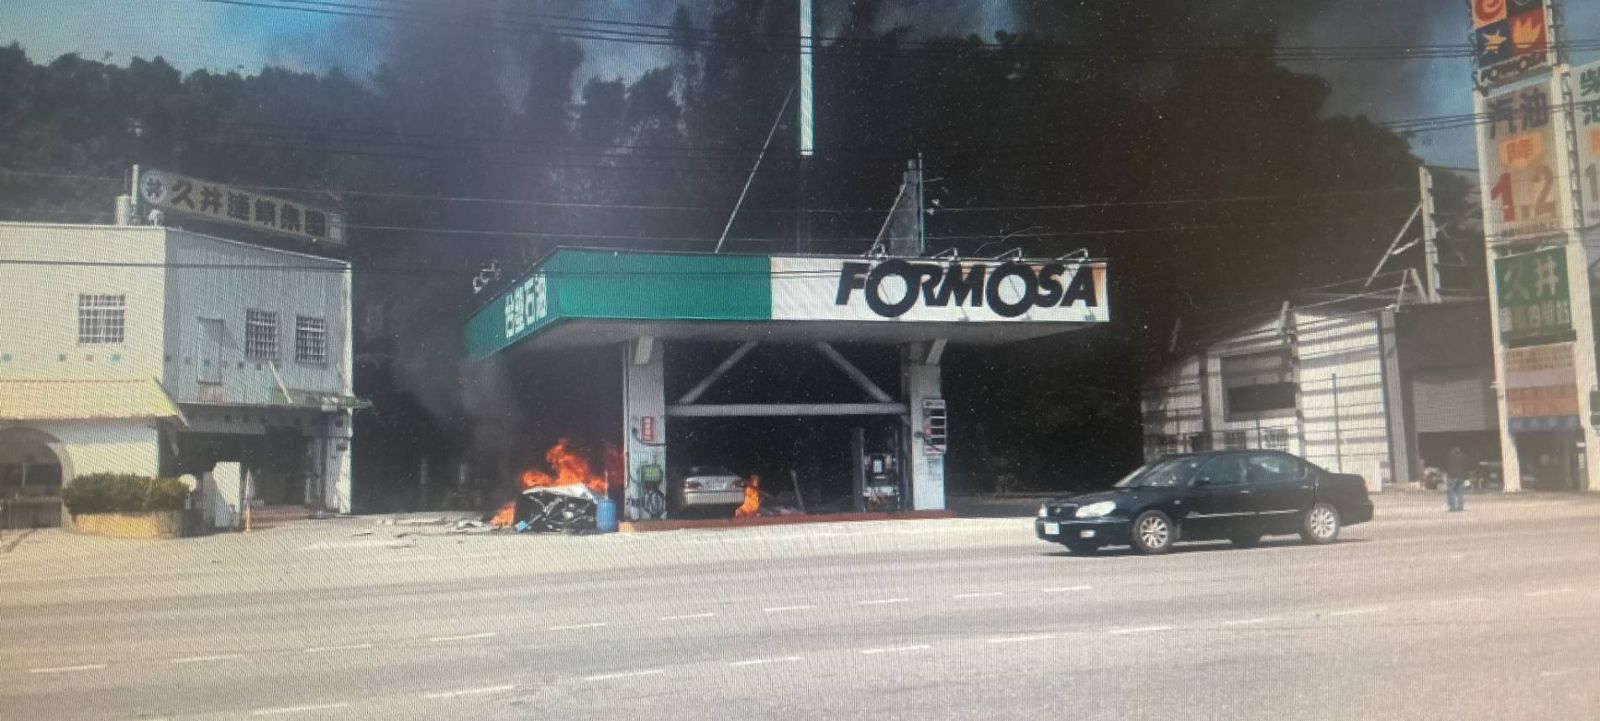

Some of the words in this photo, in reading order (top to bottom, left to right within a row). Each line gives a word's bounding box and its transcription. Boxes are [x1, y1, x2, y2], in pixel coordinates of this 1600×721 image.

[1487, 88, 1549, 140] 汽油
[835, 258, 1099, 317] FORMOSA
[1503, 255, 1560, 301] 久井
